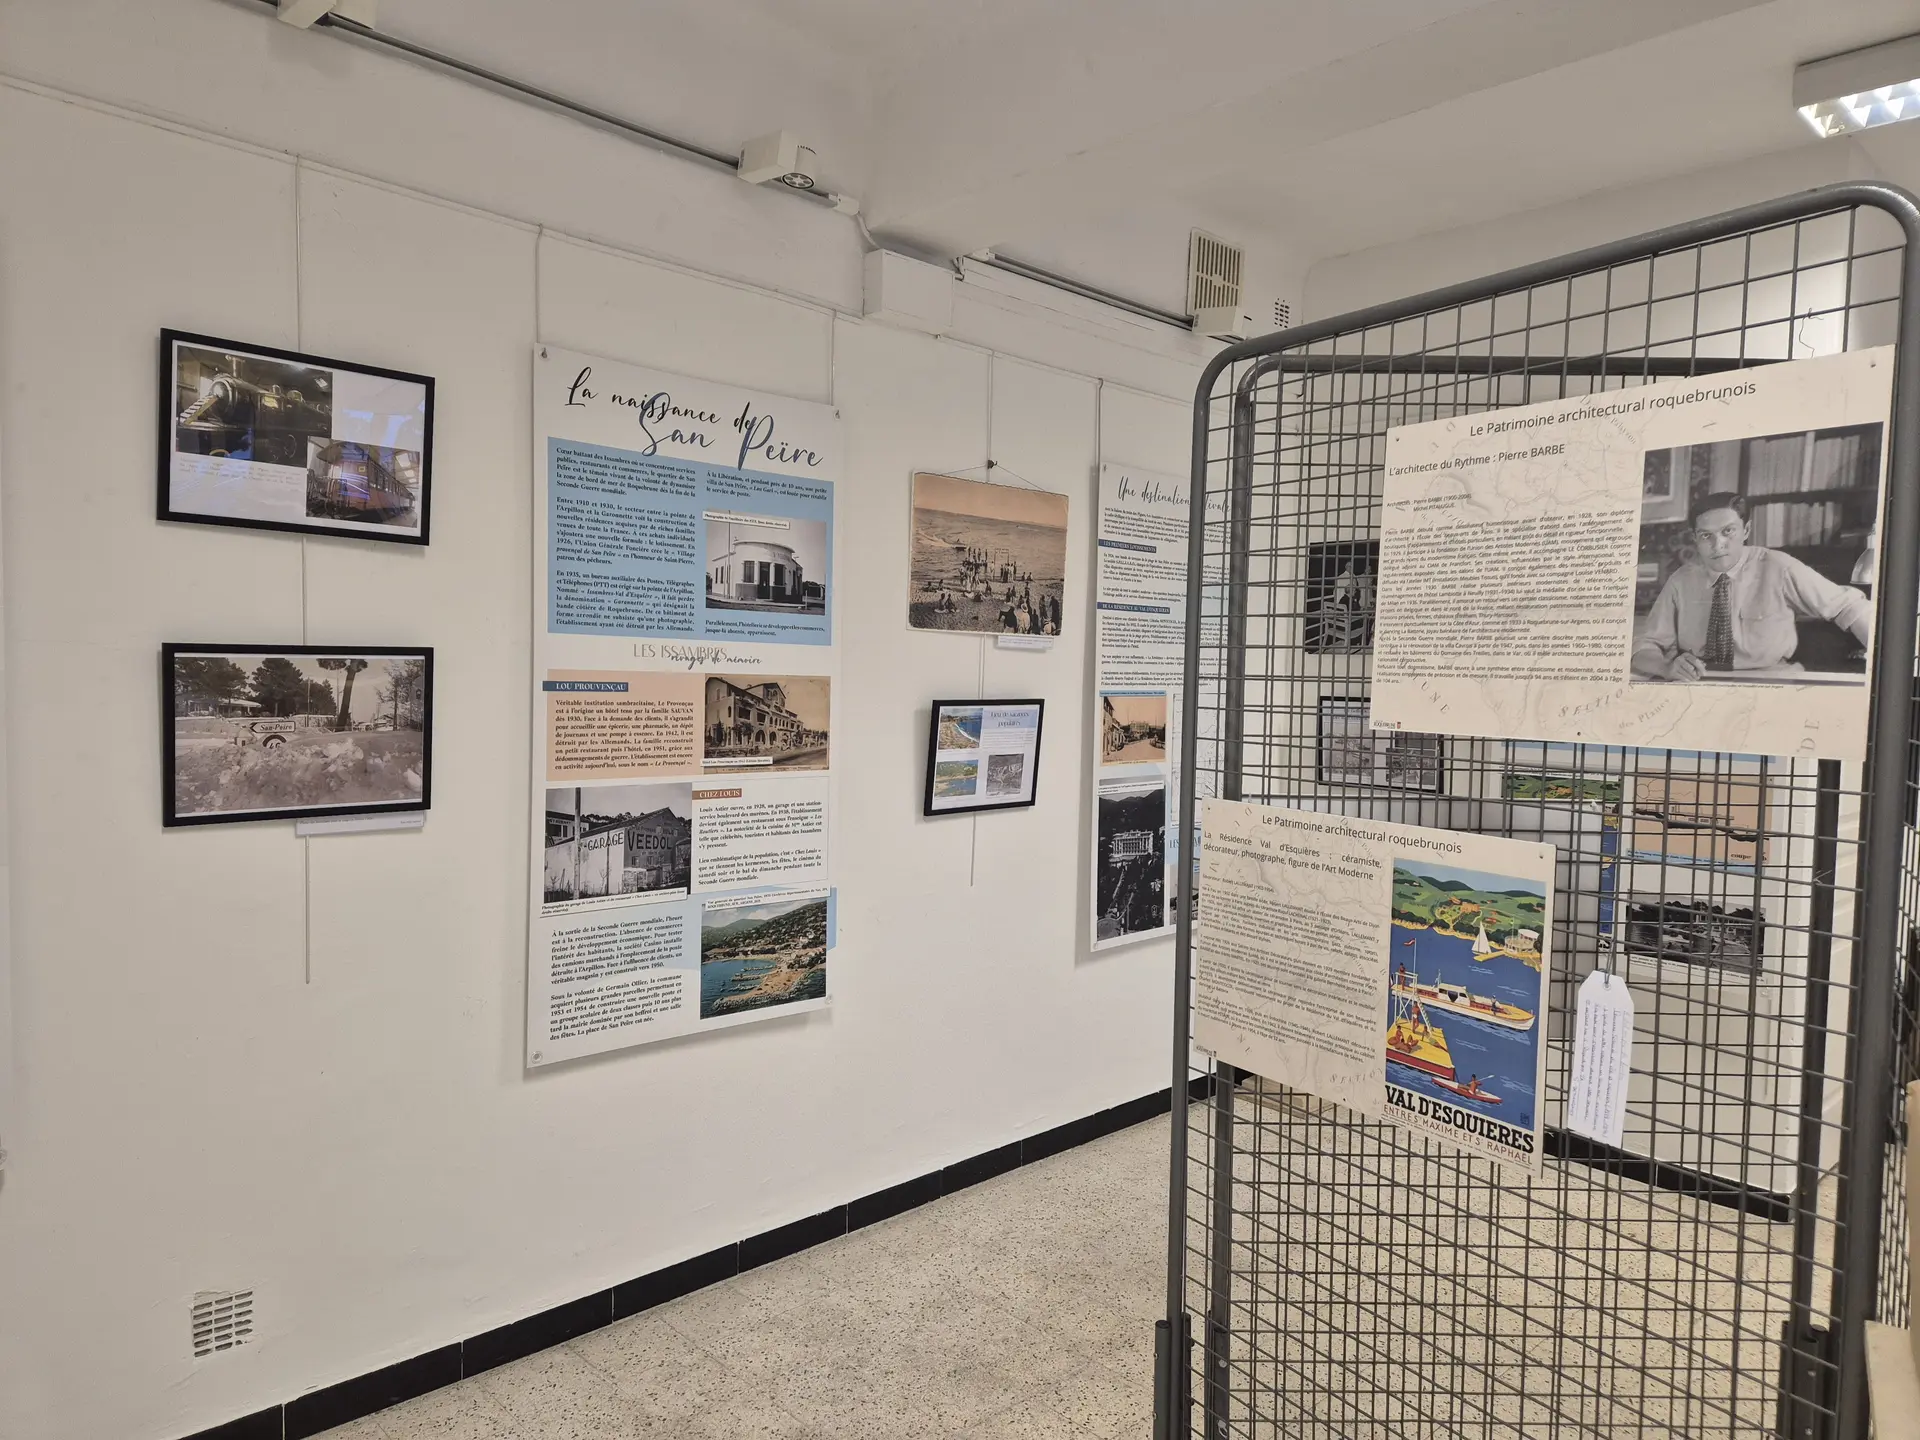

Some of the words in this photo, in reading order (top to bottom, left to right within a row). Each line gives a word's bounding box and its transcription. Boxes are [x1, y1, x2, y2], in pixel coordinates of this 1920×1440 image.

[565, 366, 598, 407] La
[612, 394, 721, 424] naissance
[734, 401, 756, 434] de
[1470, 424, 1484, 437] Le
[1486, 413, 1555, 434] Patrimoine
[1557, 397, 1645, 424] architectural
[1649, 382, 1757, 410] roquebrunois
[639, 392, 716, 457] San
[738, 414, 823, 471] Peïre
[1389, 464, 1438, 476] L'architecte
[1440, 460, 1452, 470] du
[1454, 456, 1490, 472] Rythme
[1498, 451, 1528, 462] Pierre
[1530, 444, 1565, 458] BARBE
[633, 644, 656, 658] LES
[574, 683, 626, 692] PROUVENÇAU
[628, 830, 672, 851] VEEDOL
[1220, 834, 1252, 846] Résidence
[1260, 840, 1271, 849] Val
[1279, 843, 1320, 858] d'Esquières
[1342, 855, 1382, 869] céramiste,
[1262, 814, 1272, 825] Le
[1275, 816, 1322, 833] Patrimoine
[1325, 824, 1386, 842] architectural
[1389, 834, 1462, 853] roquebrunois
[1204, 843, 1239, 857] décorateur,
[1241, 849, 1287, 865] photographe,
[1288, 857, 1309, 870] figure
[1310, 862, 1320, 870] de
[1321, 864, 1336, 874] l'Art
[1338, 867, 1374, 880] Moderne
[1384, 1104, 1412, 1121] ENTRE
[1422, 1116, 1459, 1139] MAXIME
[1462, 1134, 1472, 1143] ET
[1385, 1085, 1416, 1112] VAL
[1418, 1098, 1534, 1154] D'ESQUIERES
